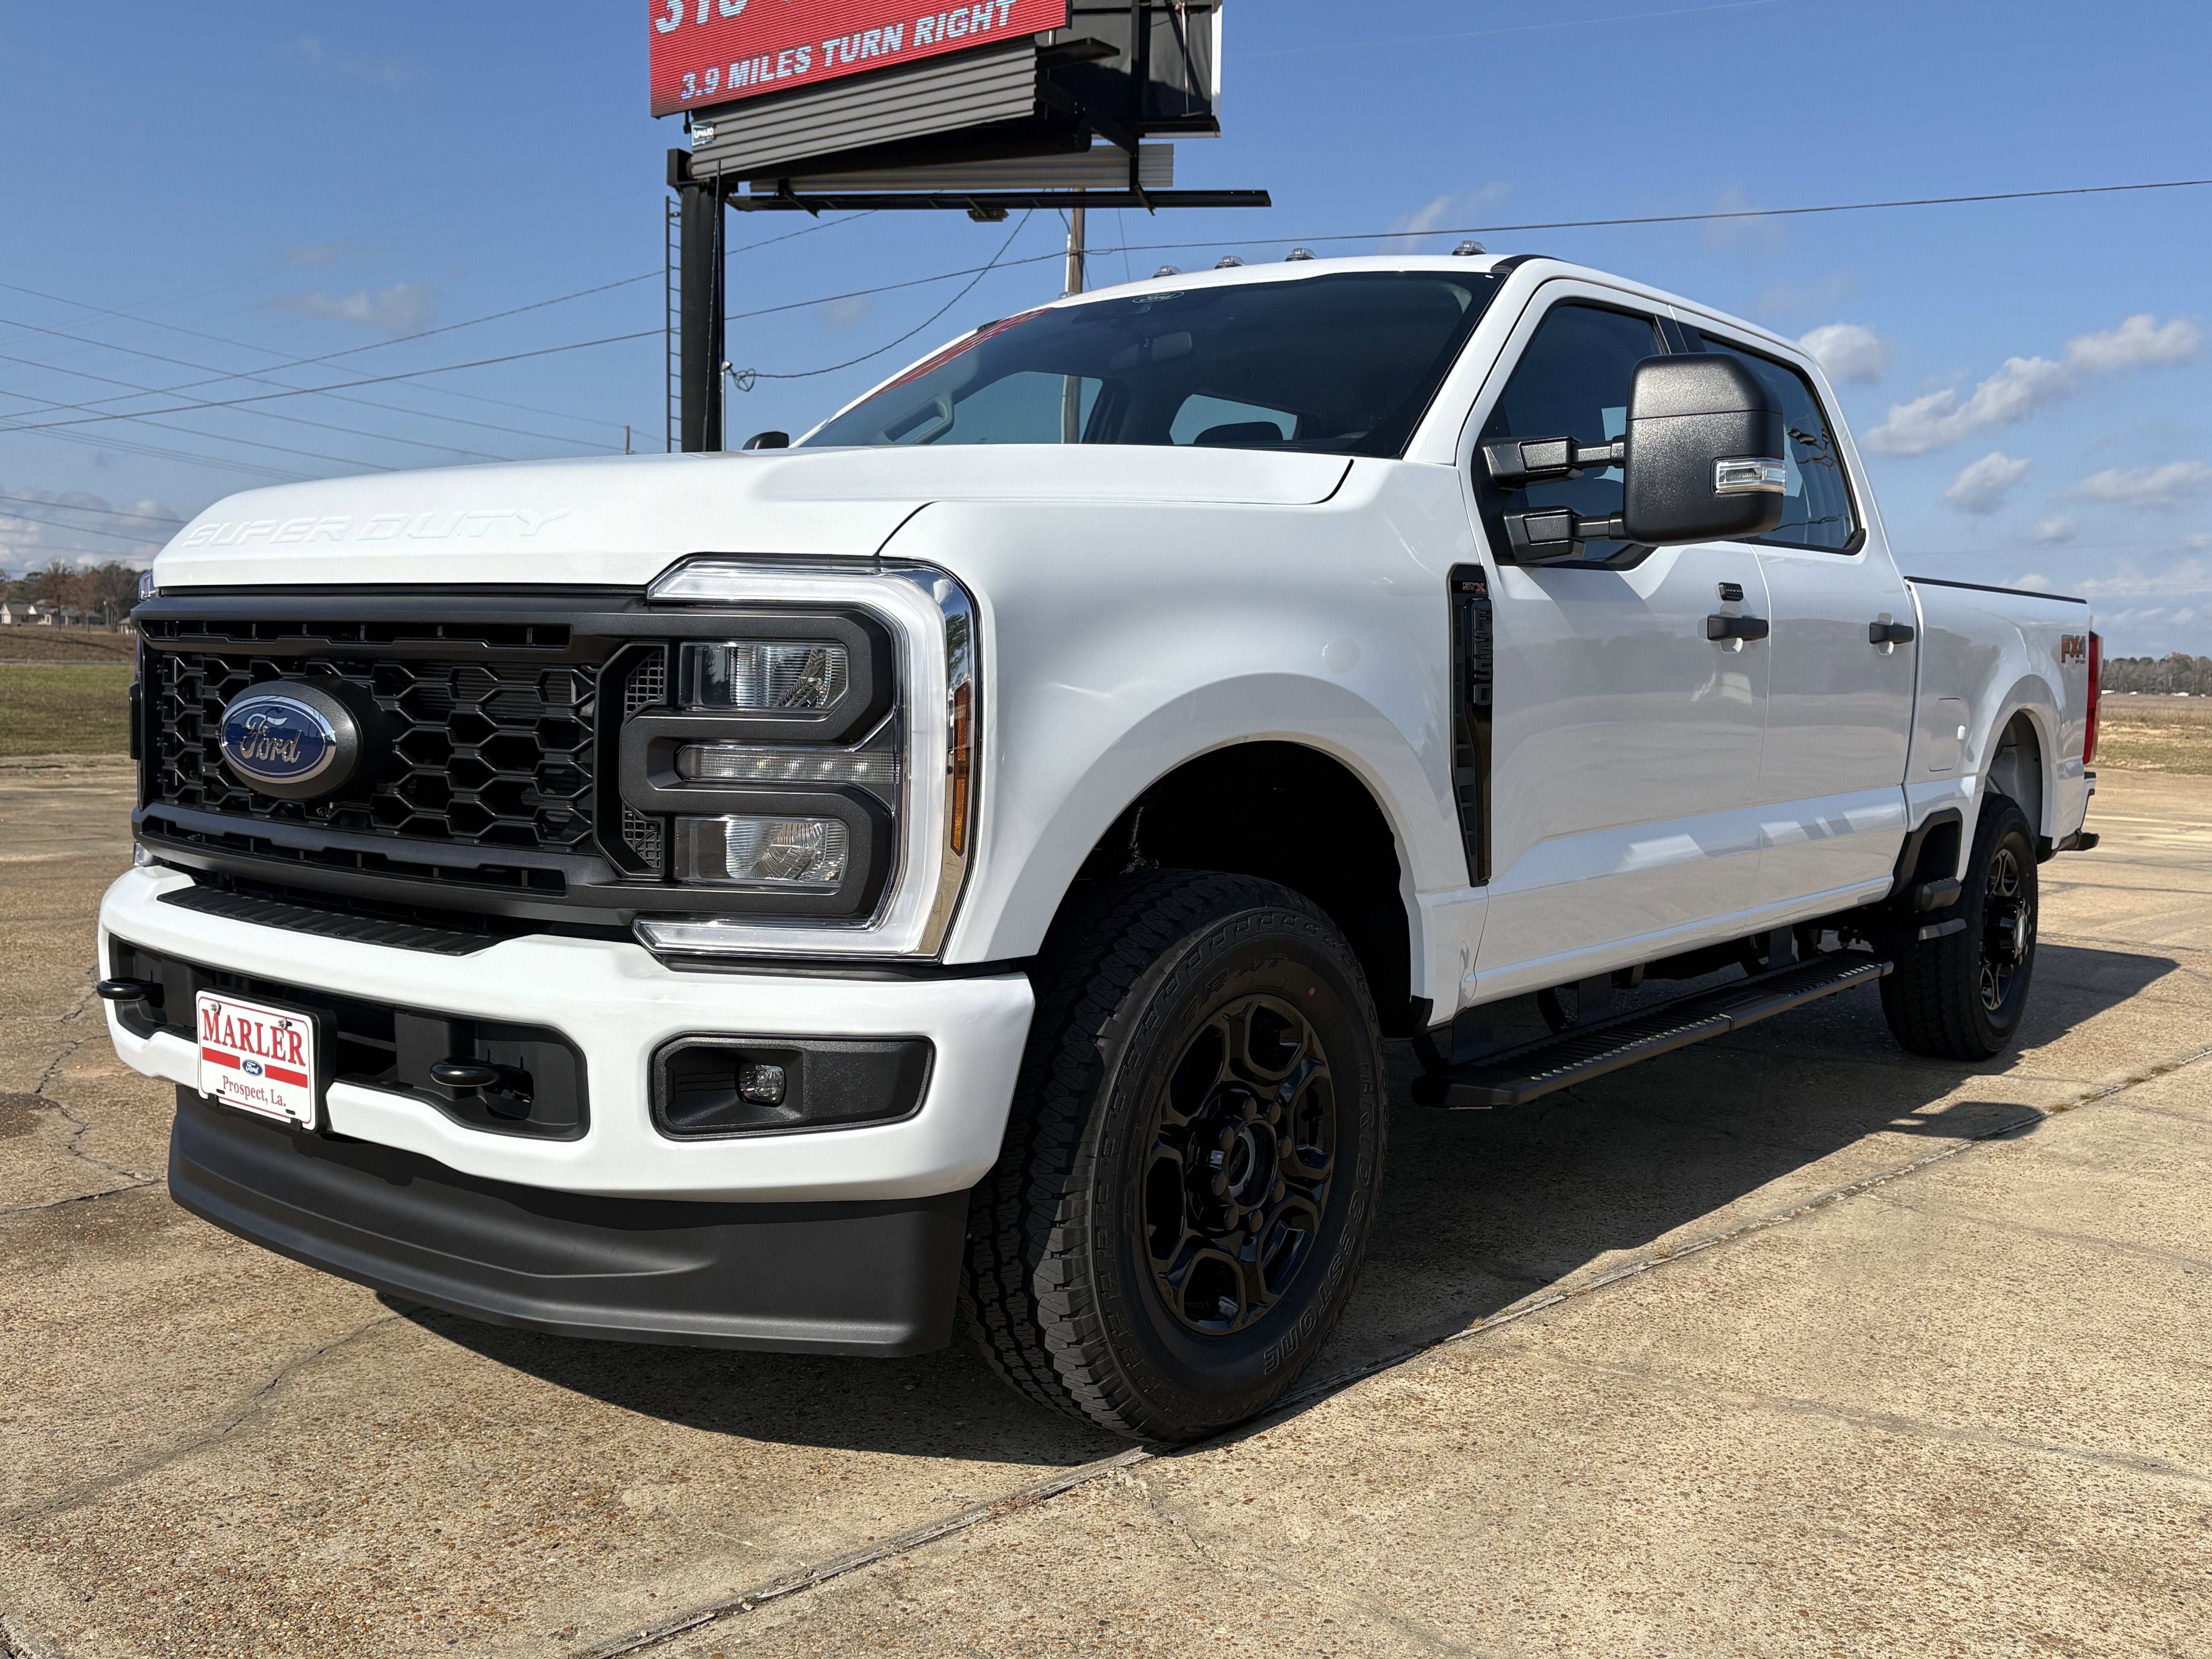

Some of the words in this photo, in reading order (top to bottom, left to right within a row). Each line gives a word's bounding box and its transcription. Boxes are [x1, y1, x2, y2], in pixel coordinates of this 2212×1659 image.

[680, 67, 719, 100] 3.9
[727, 45, 812, 90] MILES
[822, 23, 904, 67] TURN
[913, 0, 1017, 46] RIGHT
[181, 516, 354, 547] SUPER
[357, 508, 572, 540] DUTY
[2061, 634, 2086, 663] FX4
[240, 713, 302, 763] Ford
[202, 1008, 306, 1067] MARLER
[222, 1075, 268, 1105] Prospect,
[270, 1089, 286, 1107] La.
[1263, 1063, 1374, 1376] BRIDGESTONE
